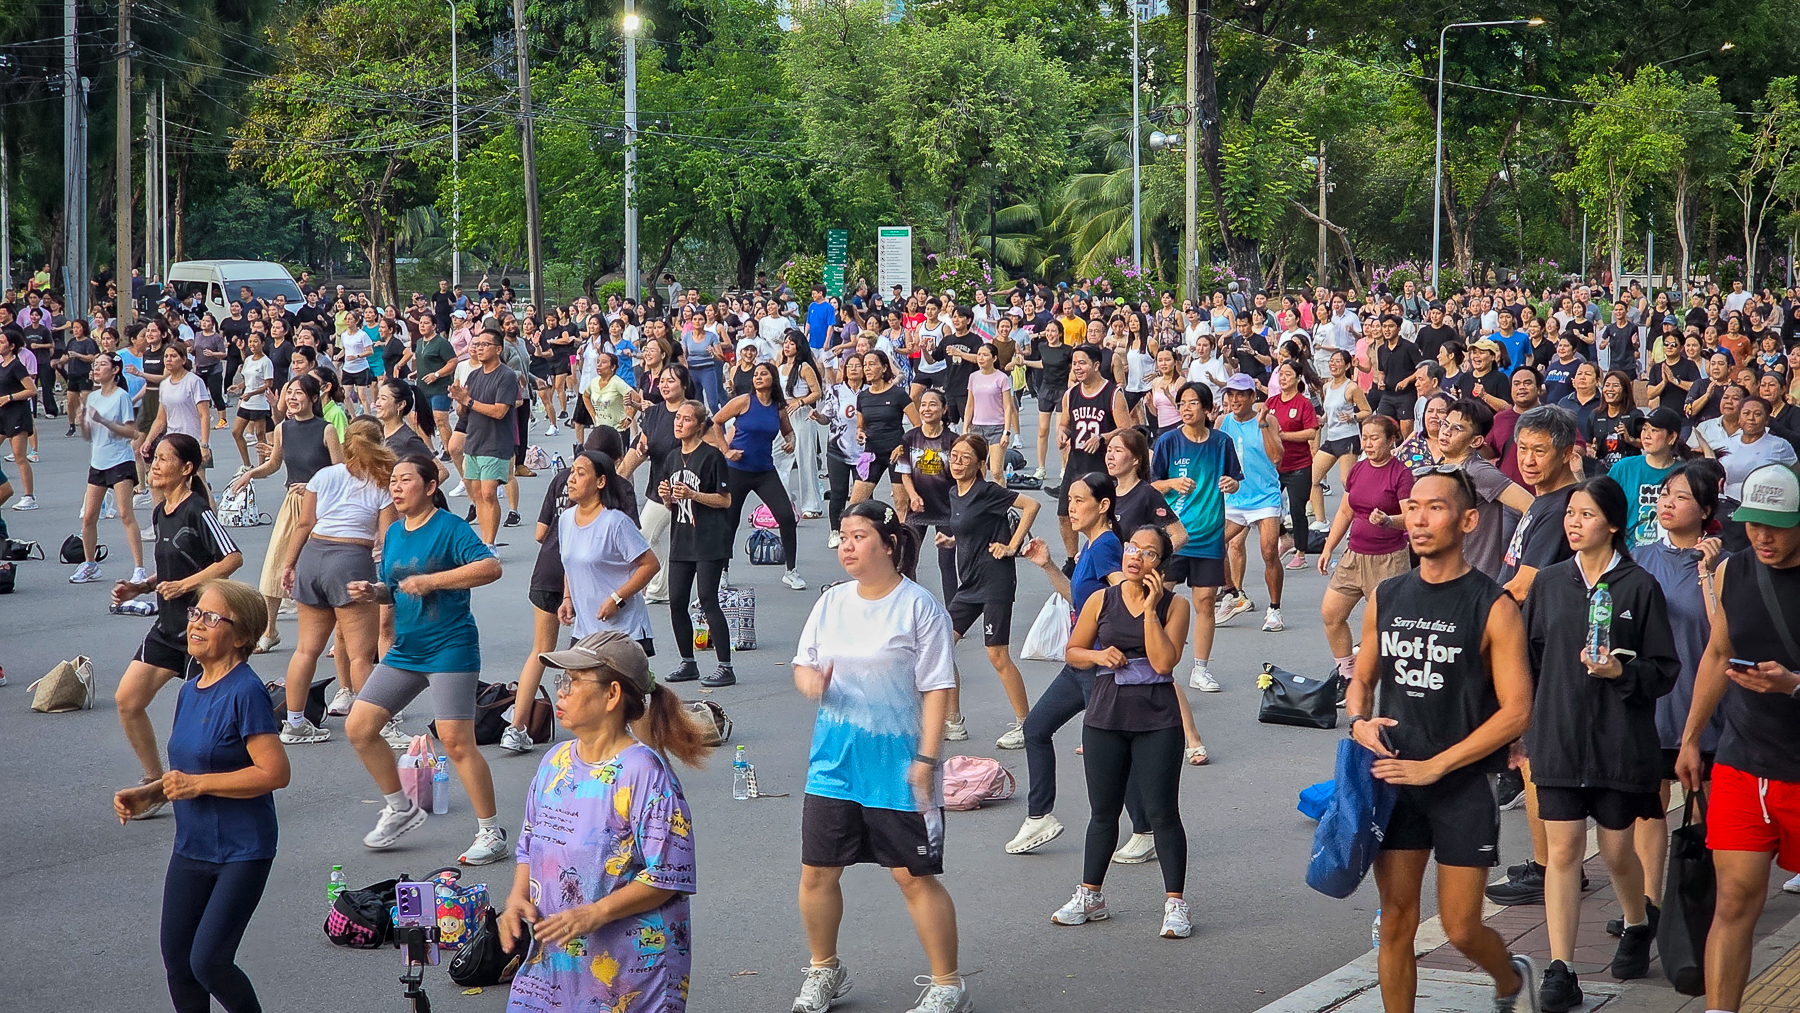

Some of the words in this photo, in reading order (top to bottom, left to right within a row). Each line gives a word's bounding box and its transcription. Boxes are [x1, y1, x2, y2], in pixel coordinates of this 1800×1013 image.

[1071, 406, 1106, 421] BULLS
[682, 469, 701, 493] YORK
[1391, 616, 1418, 630] Sorry
[1415, 617, 1432, 630] but
[1430, 619, 1448, 632] this
[1446, 622, 1457, 633] is
[1381, 631, 1425, 660] Not
[1426, 633, 1463, 664] for
[1394, 658, 1445, 691] Sale
[625, 927, 645, 937] NOT
[649, 924, 665, 935] ALL
